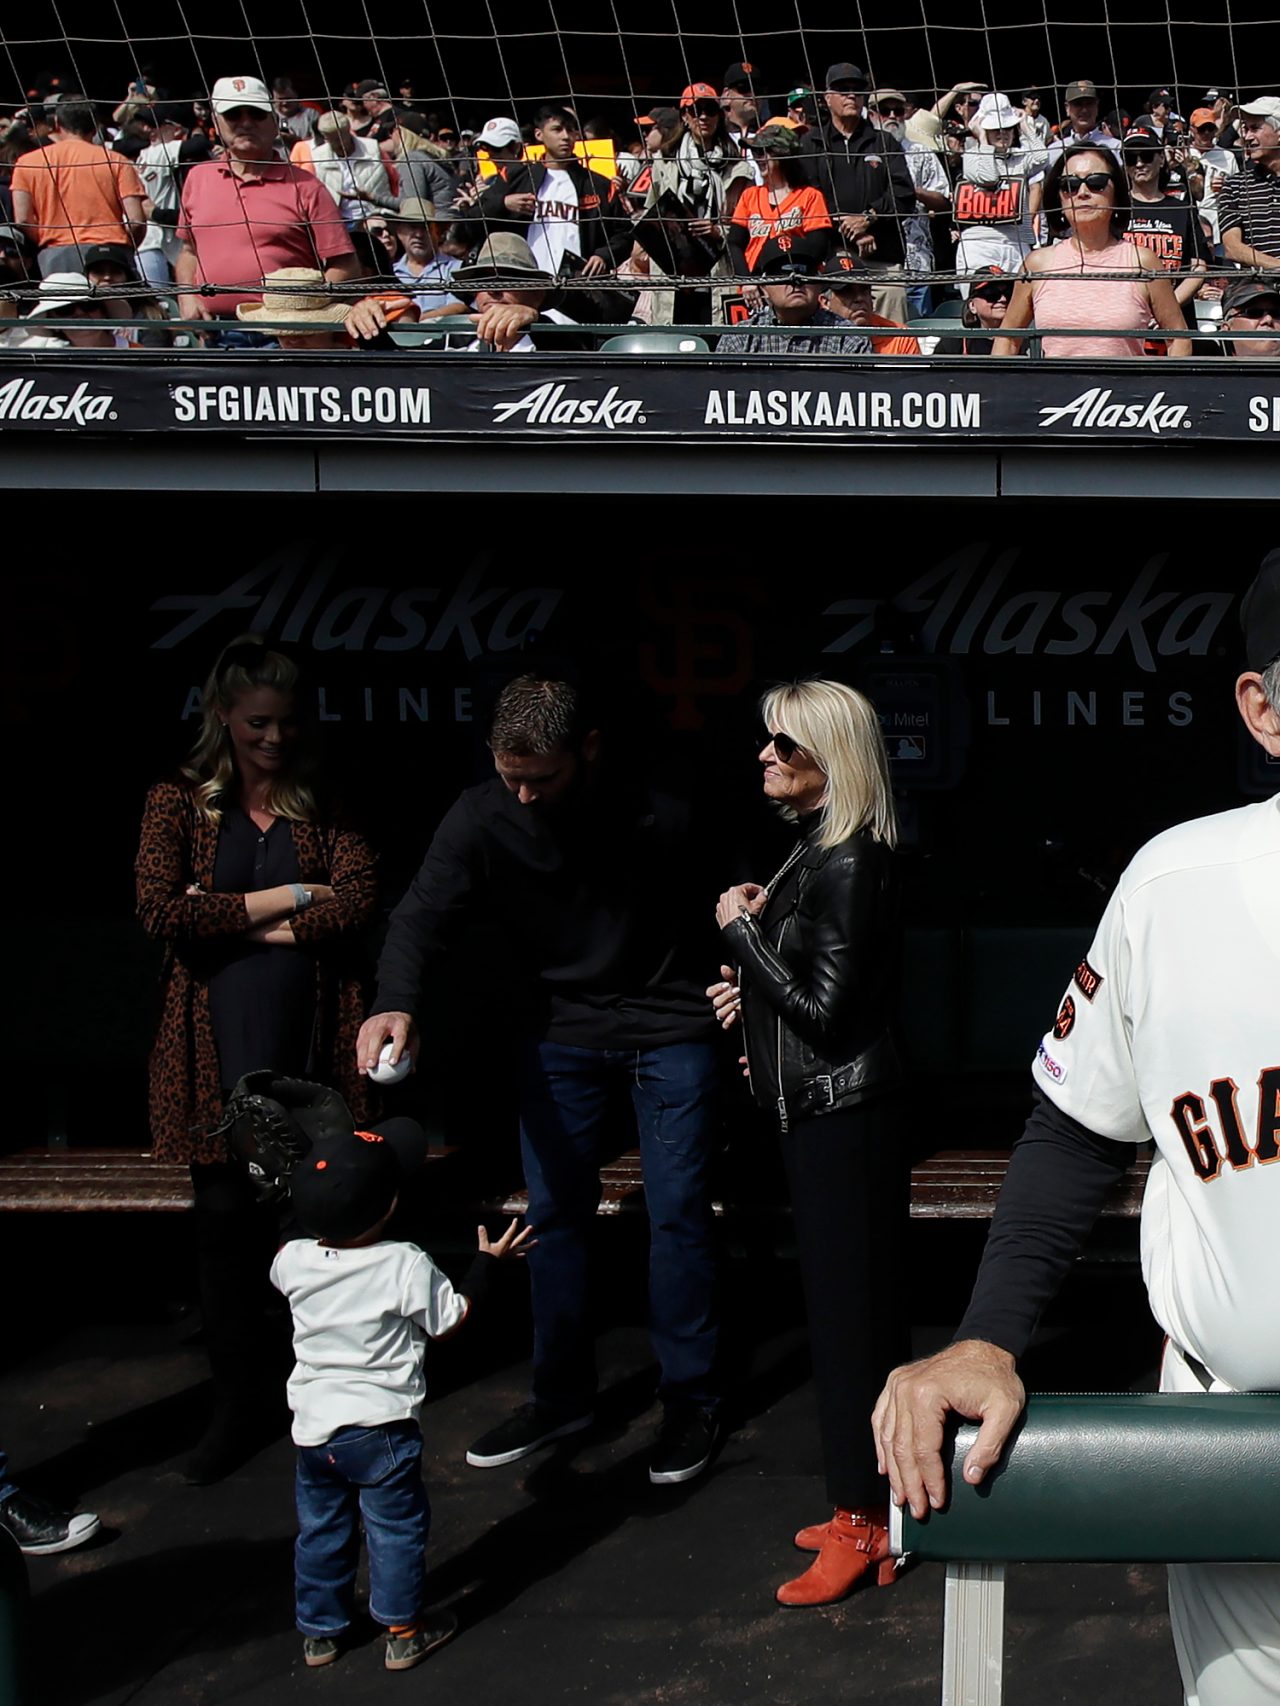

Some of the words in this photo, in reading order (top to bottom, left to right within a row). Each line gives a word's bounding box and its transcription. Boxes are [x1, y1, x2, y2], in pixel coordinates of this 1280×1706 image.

[0, 378, 114, 425] Alaska
[175, 386, 431, 424] SFGIANTS.COM
[493, 383, 643, 428] Alaska
[704, 390, 980, 428] ALASKAAIR.COM
[1038, 388, 1190, 434] Alaska
[148, 538, 566, 662] Alaska
[820, 539, 1237, 674] Alaska
